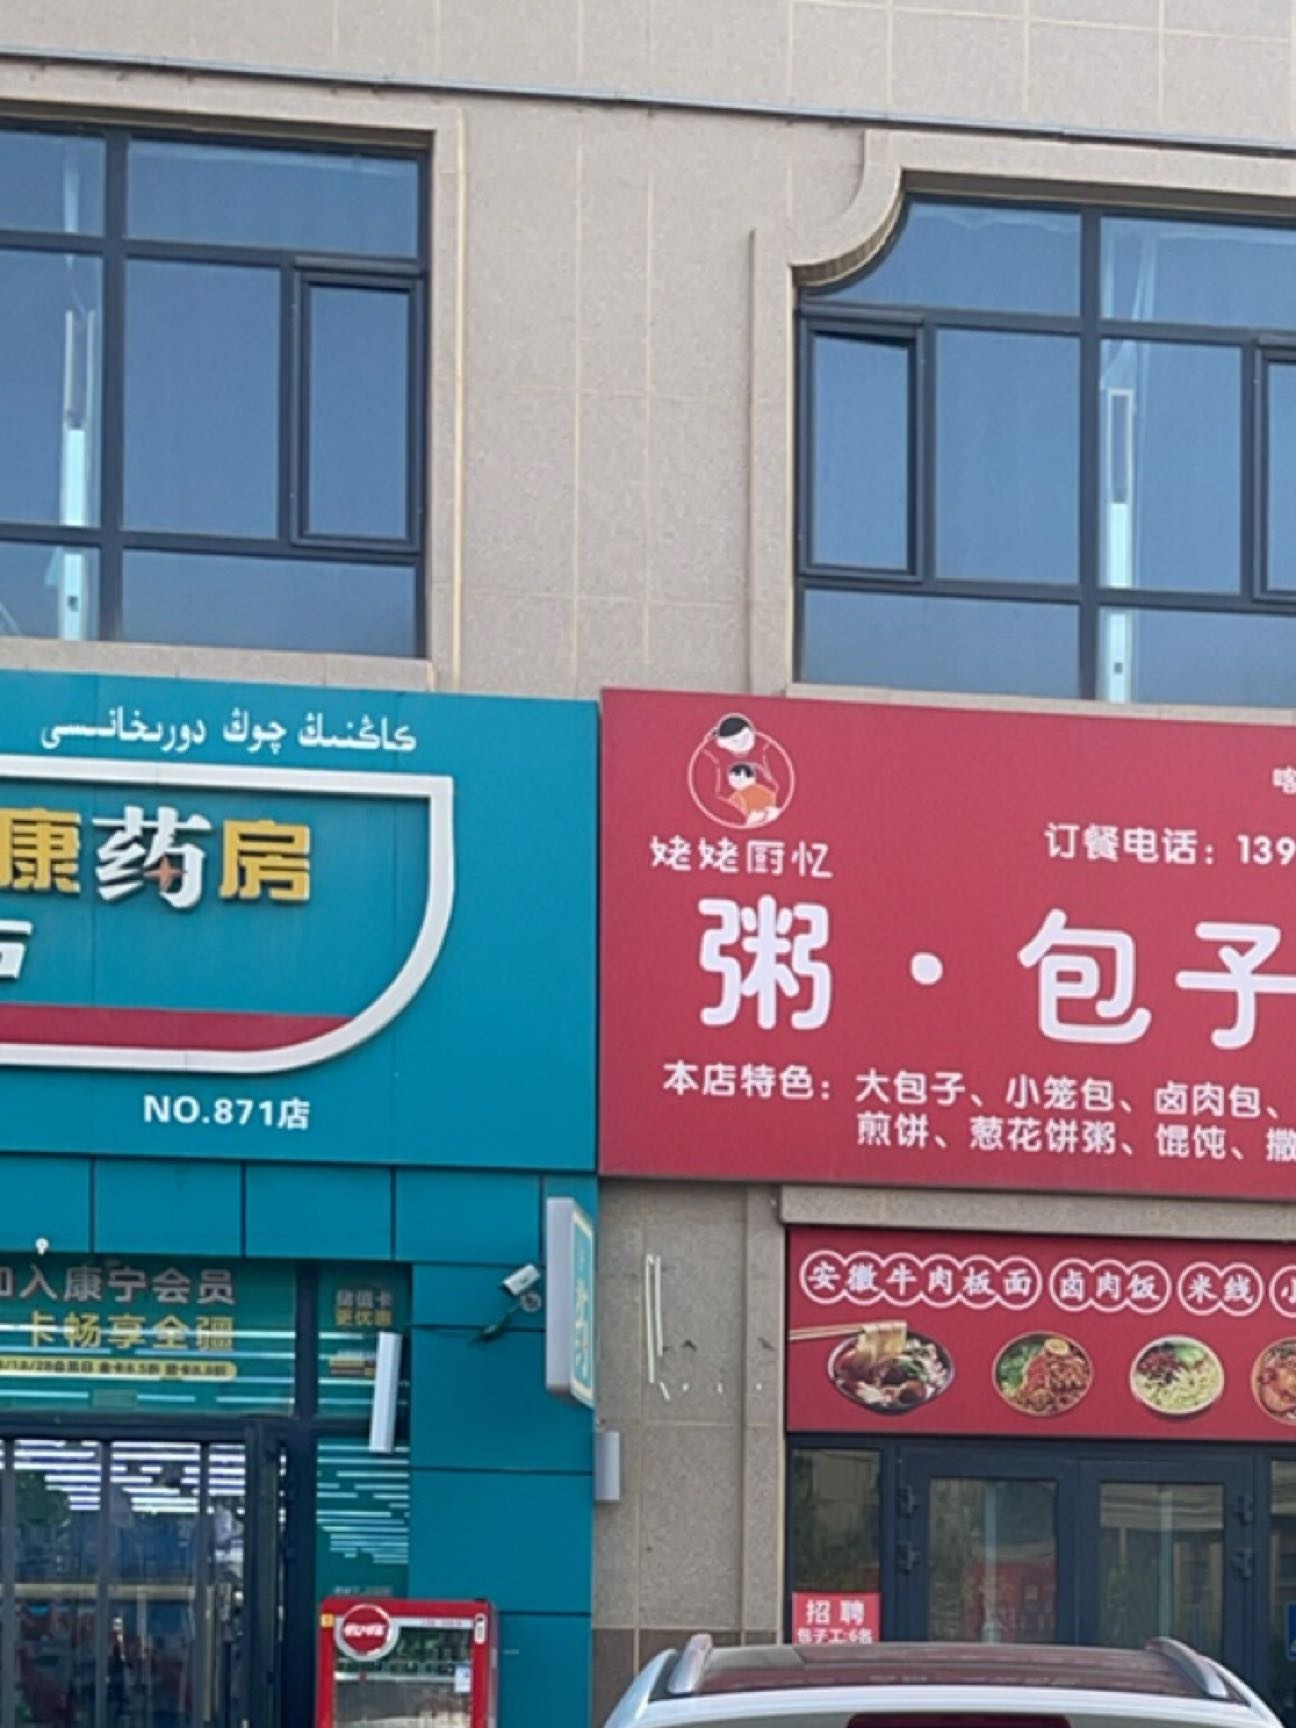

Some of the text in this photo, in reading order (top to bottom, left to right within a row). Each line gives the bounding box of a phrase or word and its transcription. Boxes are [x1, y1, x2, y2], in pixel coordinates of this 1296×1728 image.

[222, 706, 287, 755] چوڭ
[0, 805, 310, 908] 康药房
[650, 834, 834, 879] 姥姥厨忆
[143, 1093, 310, 1131] NO.871店
[806, 1258, 1033, 1298] 安徽牛肉板面
[1057, 1269, 1164, 1303] 卤肉饭
[1185, 1274, 1257, 1305] 米线
[806, 1599, 865, 1626] 招聘
